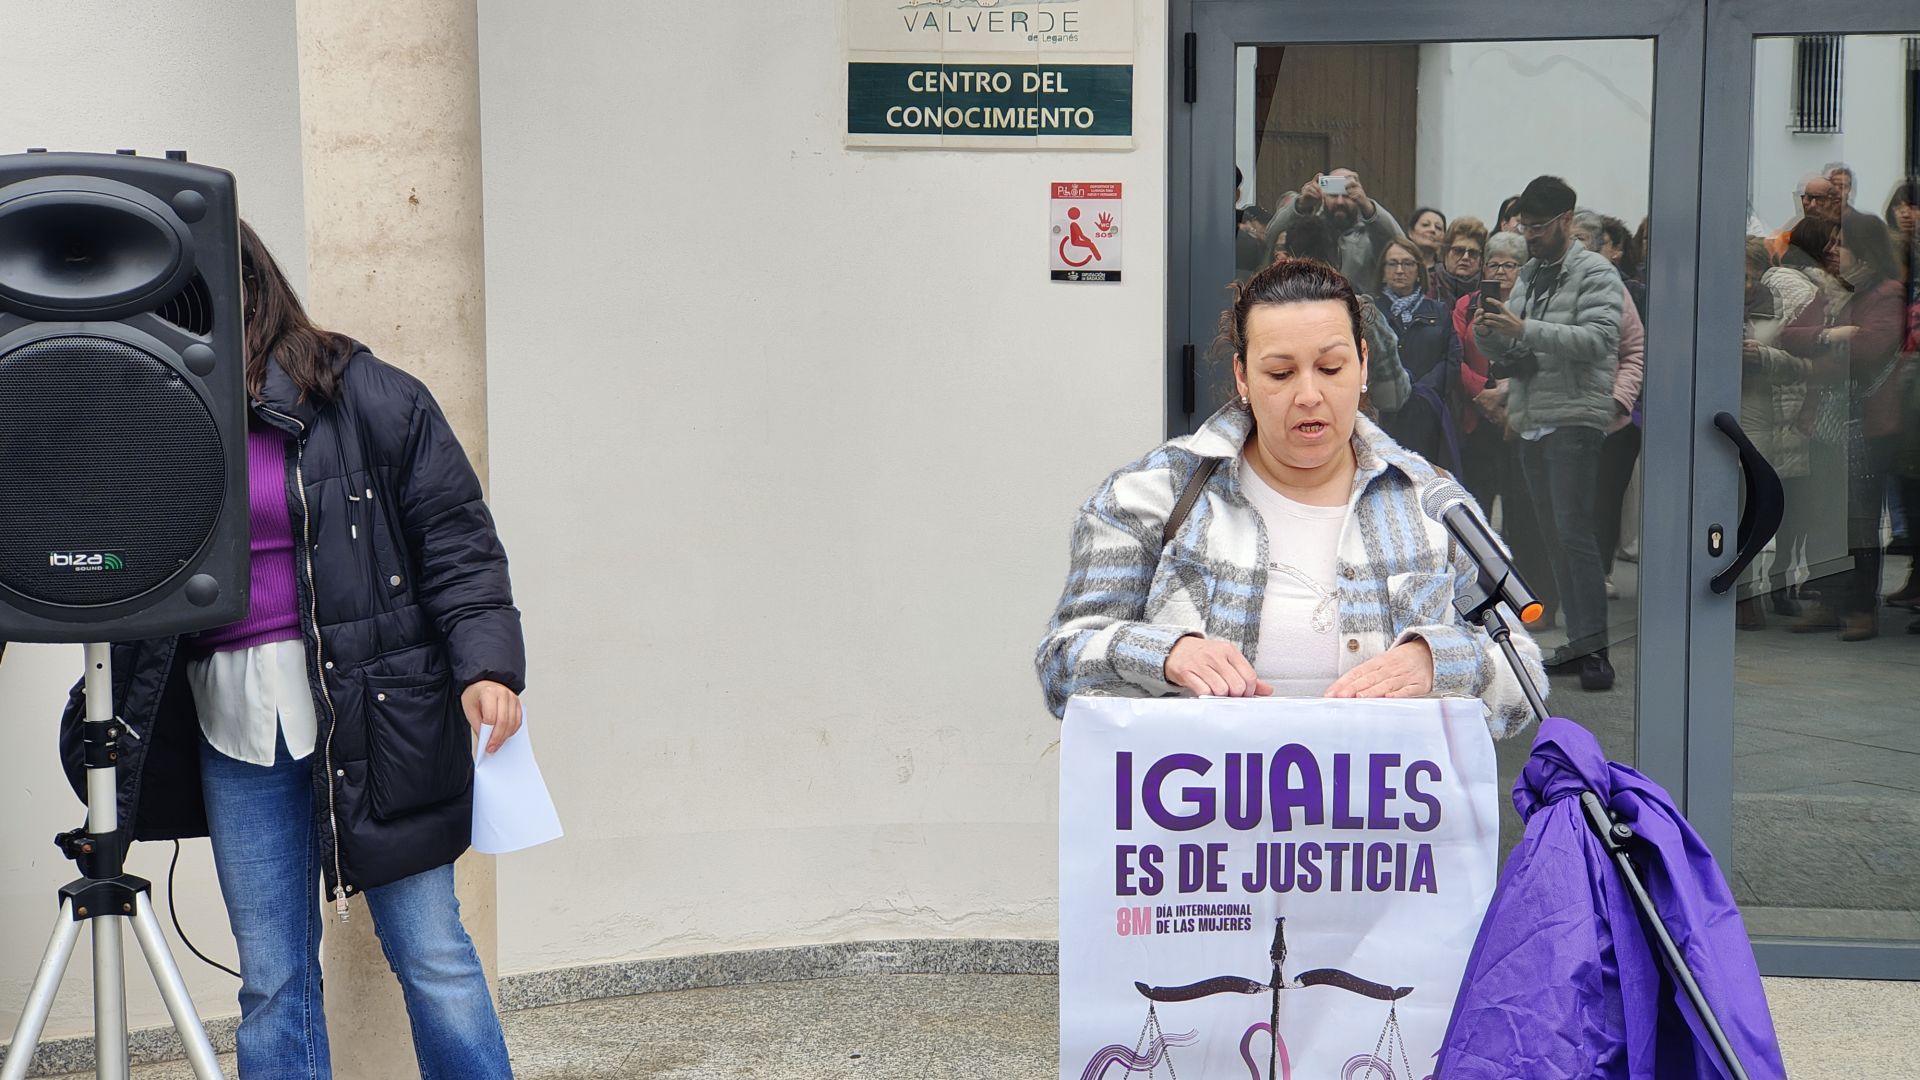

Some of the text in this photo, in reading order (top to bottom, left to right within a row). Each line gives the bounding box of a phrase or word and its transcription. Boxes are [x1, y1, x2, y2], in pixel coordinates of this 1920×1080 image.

[903, 11, 1079, 33] VALVERDE
[1028, 33, 1038, 41] de
[907, 71, 1069, 93] CENTRO DEL
[886, 106, 1095, 129] CONOCIMIENTO
[49, 552, 103, 566] ibiza
[1115, 743, 1442, 833] IGUALES
[1115, 842, 1438, 896] ES DE JUSTICIA
[1116, 906, 1152, 936] 8M
[1156, 904, 1252, 918] DÍA INTERNACIONAL
[1156, 917, 1252, 934] DE LAS MUJERES
